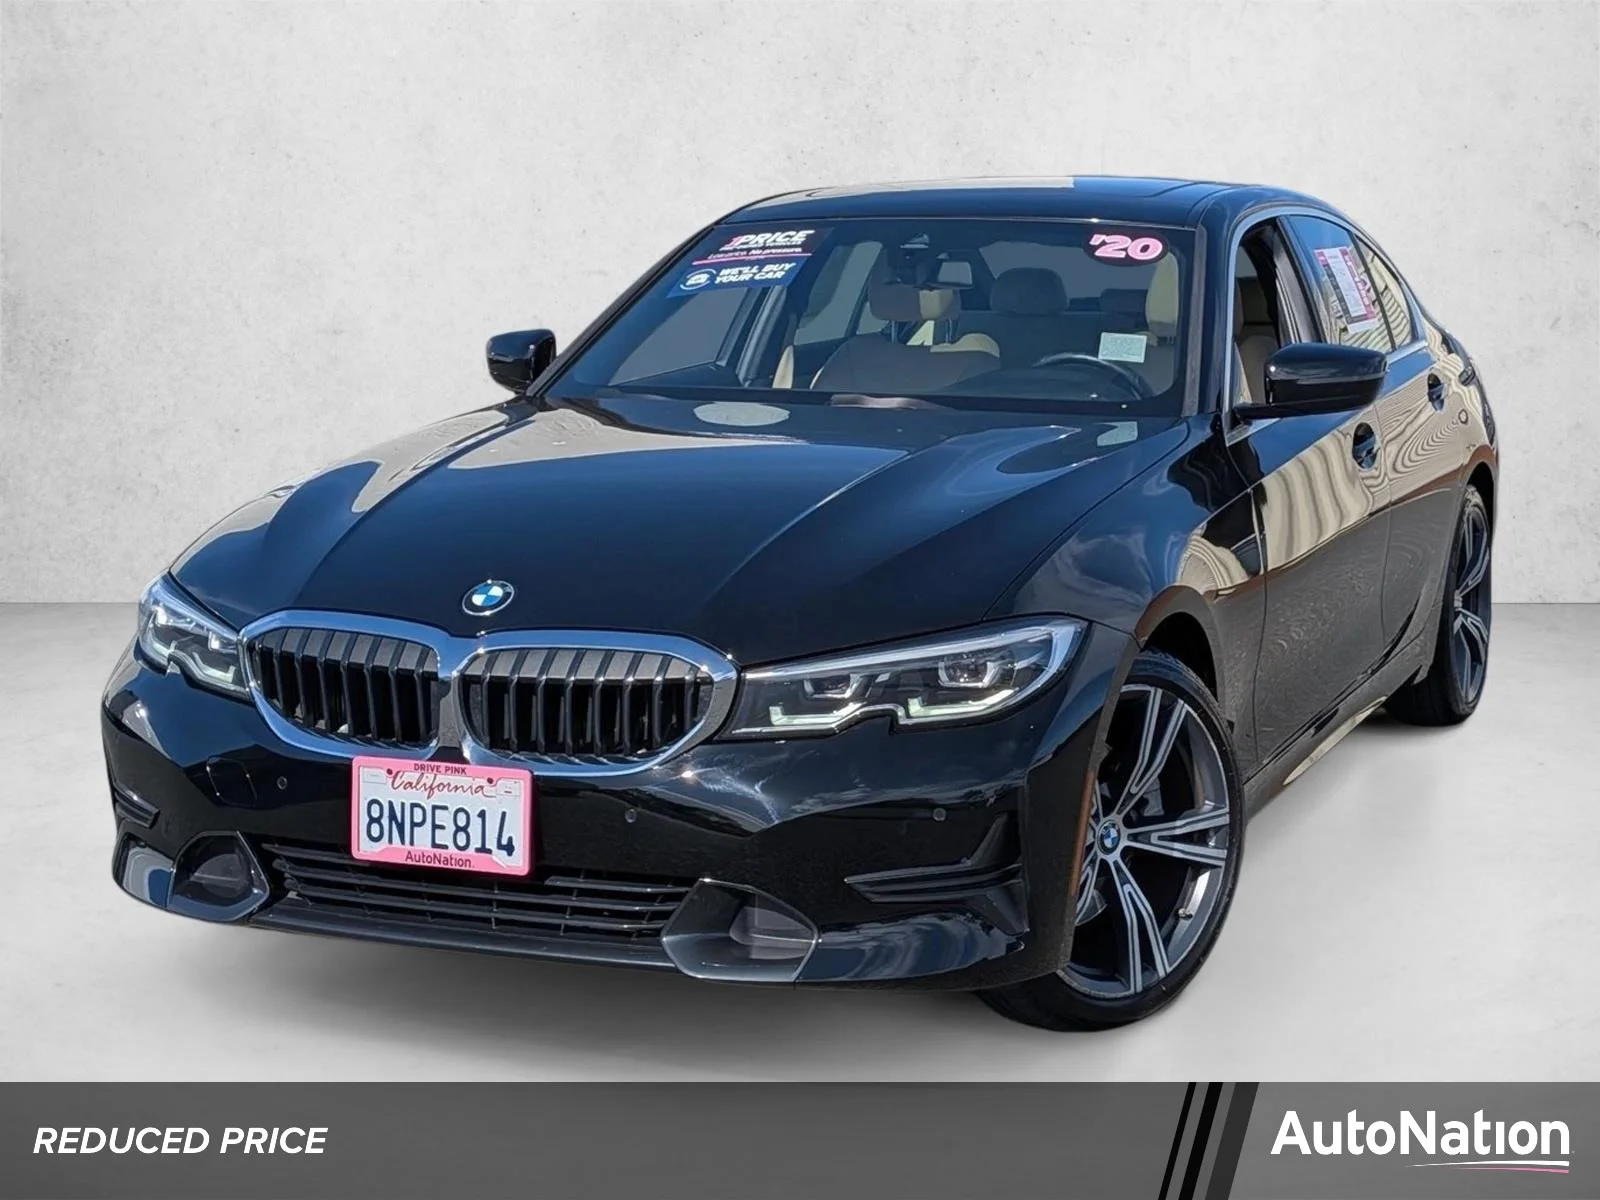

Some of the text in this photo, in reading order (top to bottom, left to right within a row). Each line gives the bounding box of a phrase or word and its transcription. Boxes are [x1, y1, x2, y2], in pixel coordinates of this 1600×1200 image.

[1089, 234, 1163, 260] '20
[761, 262, 796, 272] BUY
[714, 273, 754, 284] YOUR
[754, 271, 786, 280] CAR
[413, 763, 467, 776] DRIVE PINK
[391, 770, 496, 800] California
[366, 798, 515, 857] 8NPE814
[405, 851, 472, 868] AutoNation
